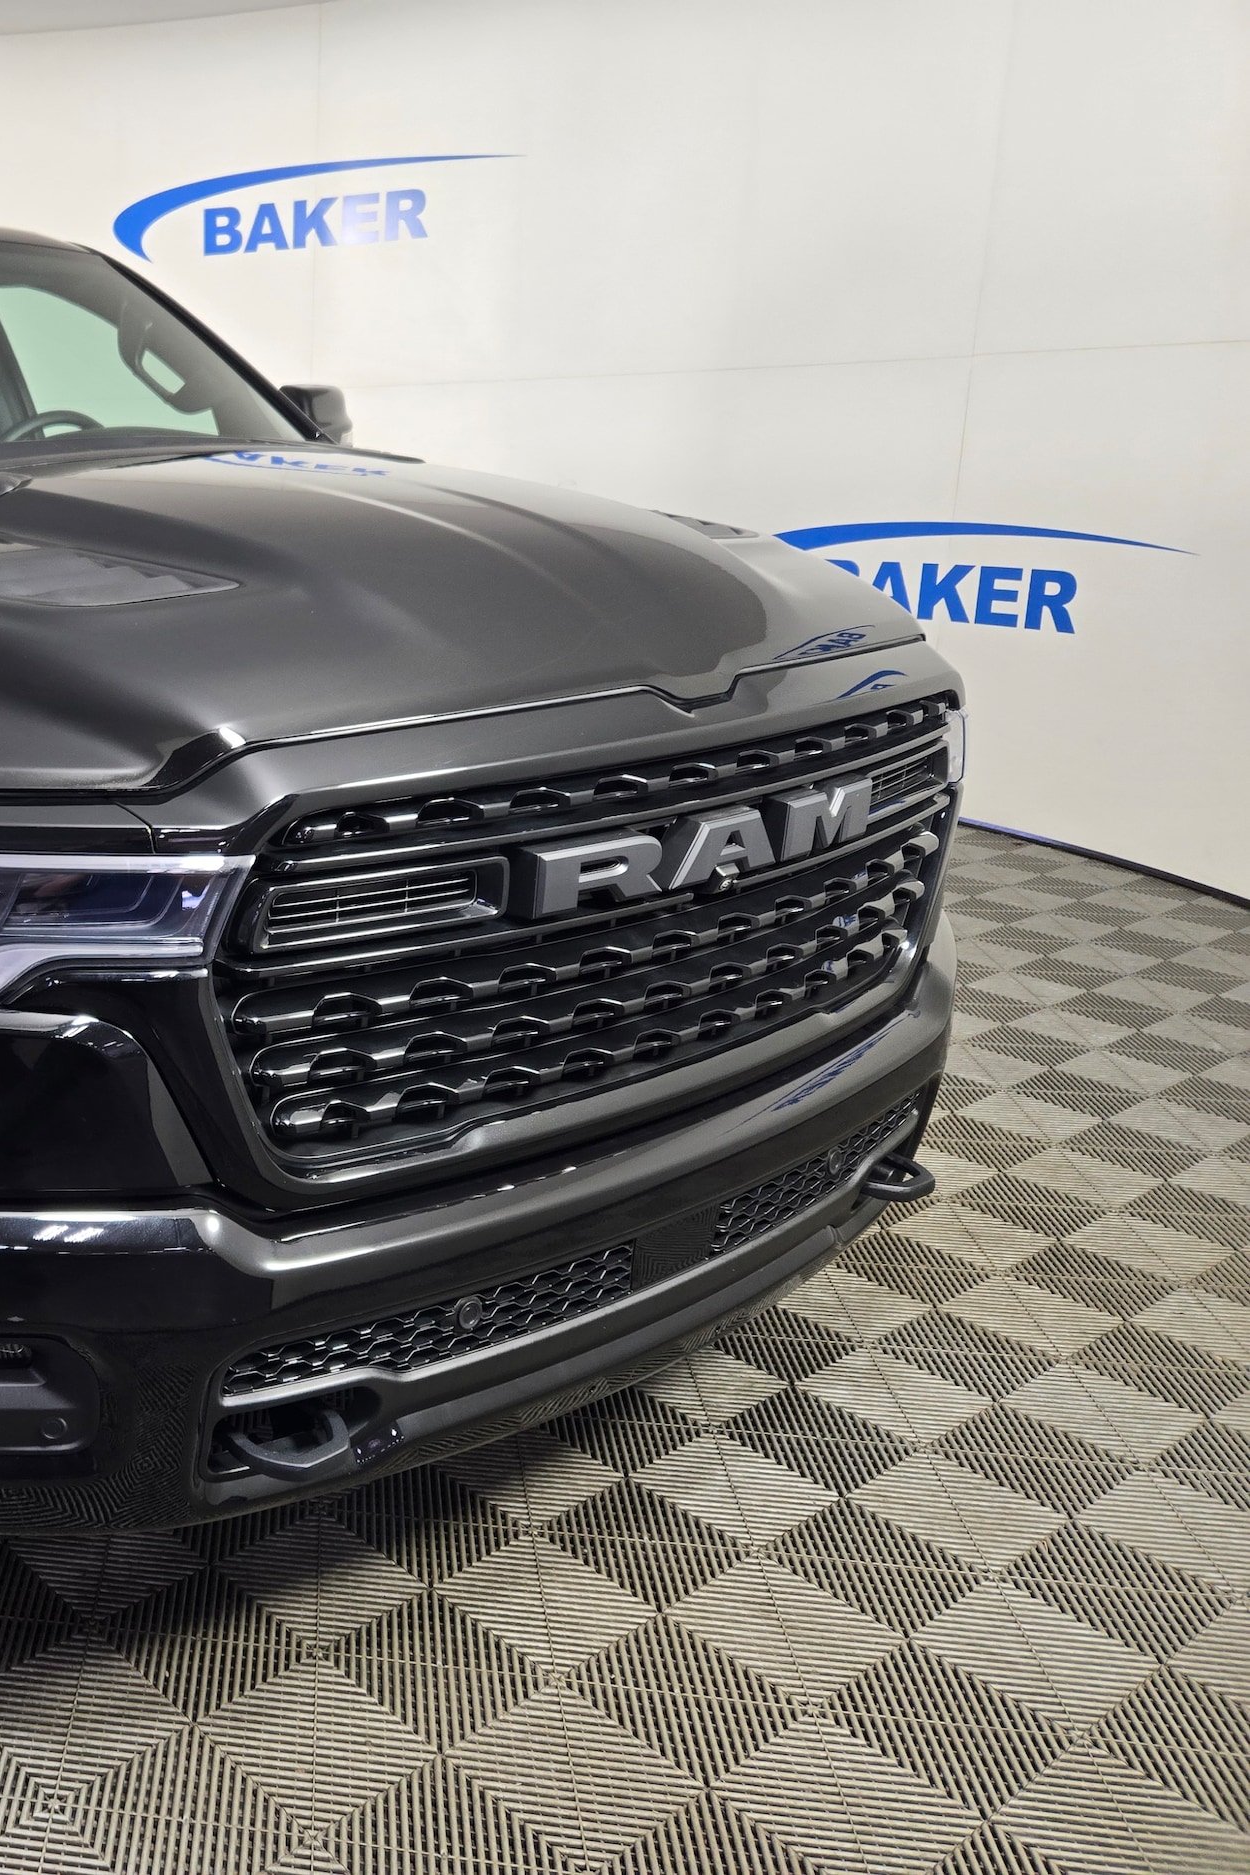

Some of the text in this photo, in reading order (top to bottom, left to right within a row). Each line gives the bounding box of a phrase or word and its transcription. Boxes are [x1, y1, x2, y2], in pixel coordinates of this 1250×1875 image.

[202, 188, 429, 257] BAKER
[825, 559, 1078, 635] AKER
[534, 774, 873, 919] RAM
